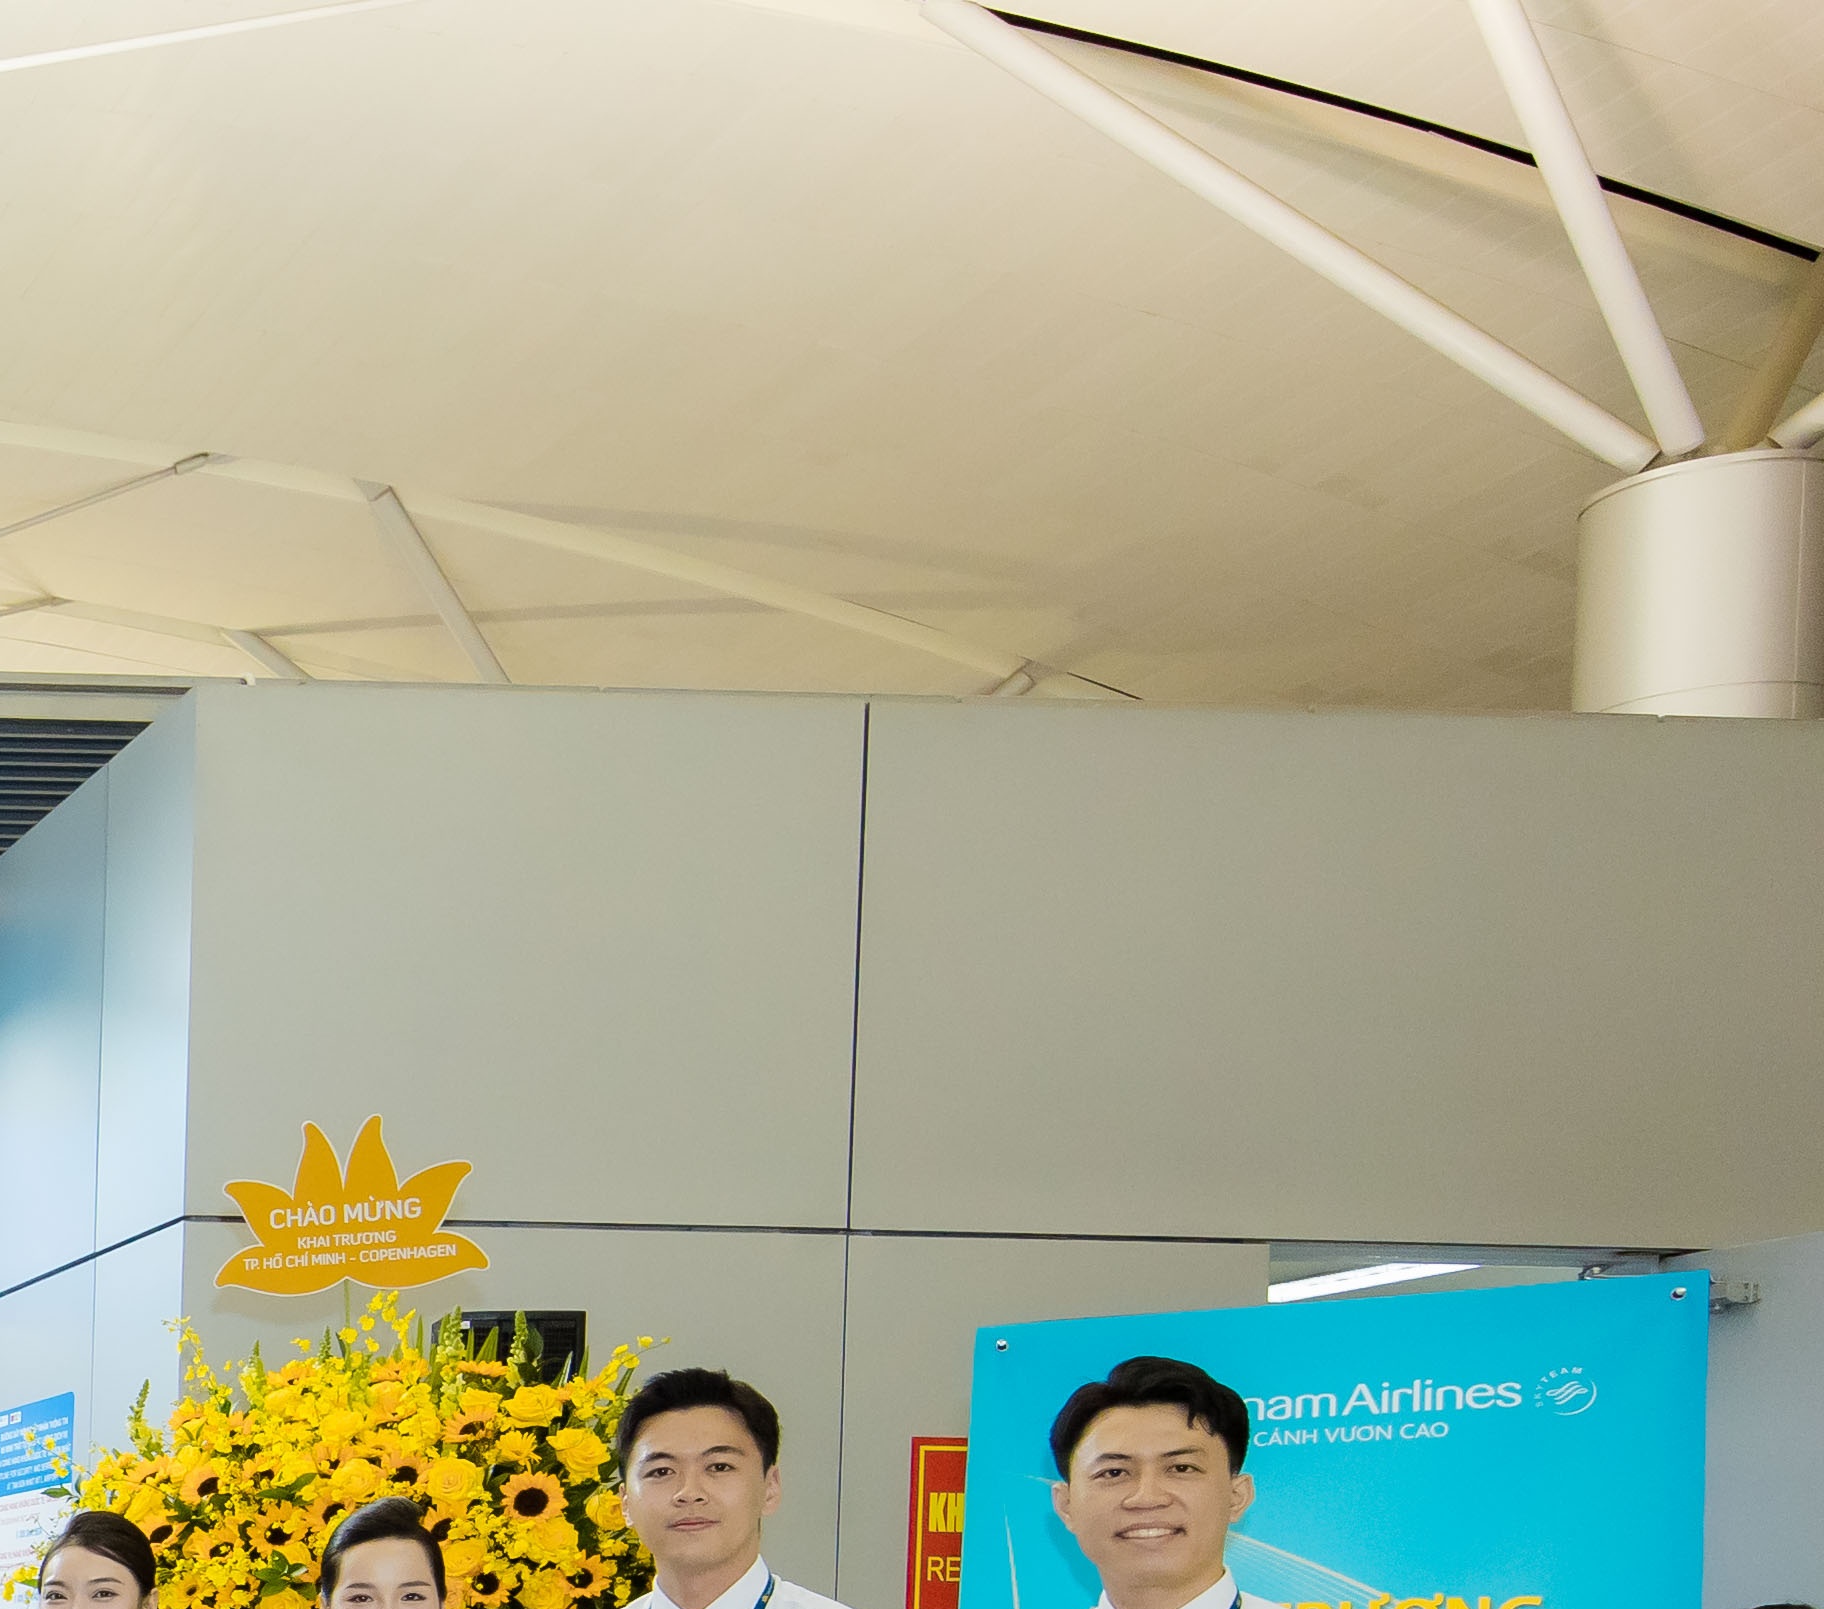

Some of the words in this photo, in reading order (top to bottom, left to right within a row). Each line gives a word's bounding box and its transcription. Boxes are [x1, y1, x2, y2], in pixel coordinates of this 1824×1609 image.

[270, 1201, 336, 1229] CHÀO
[343, 1196, 422, 1224] MỪNG
[297, 1236, 330, 1249] KHAI
[333, 1230, 397, 1247] TRƯƠNG
[243, 1257, 260, 1271] TP.
[286, 1252, 309, 1268] CHÍ
[311, 1252, 346, 1266] MINH
[359, 1244, 457, 1263] COPENHAGEN
[1244, 1395, 1337, 1421] nam
[1341, 1379, 1523, 1417] Airlines
[1253, 1425, 1317, 1447] CÁNH
[1324, 1424, 1393, 1444] VƯƠN
[1399, 1421, 1449, 1440] CAO
[928, 1491, 965, 1533] KH
[926, 1556, 961, 1582] RE
